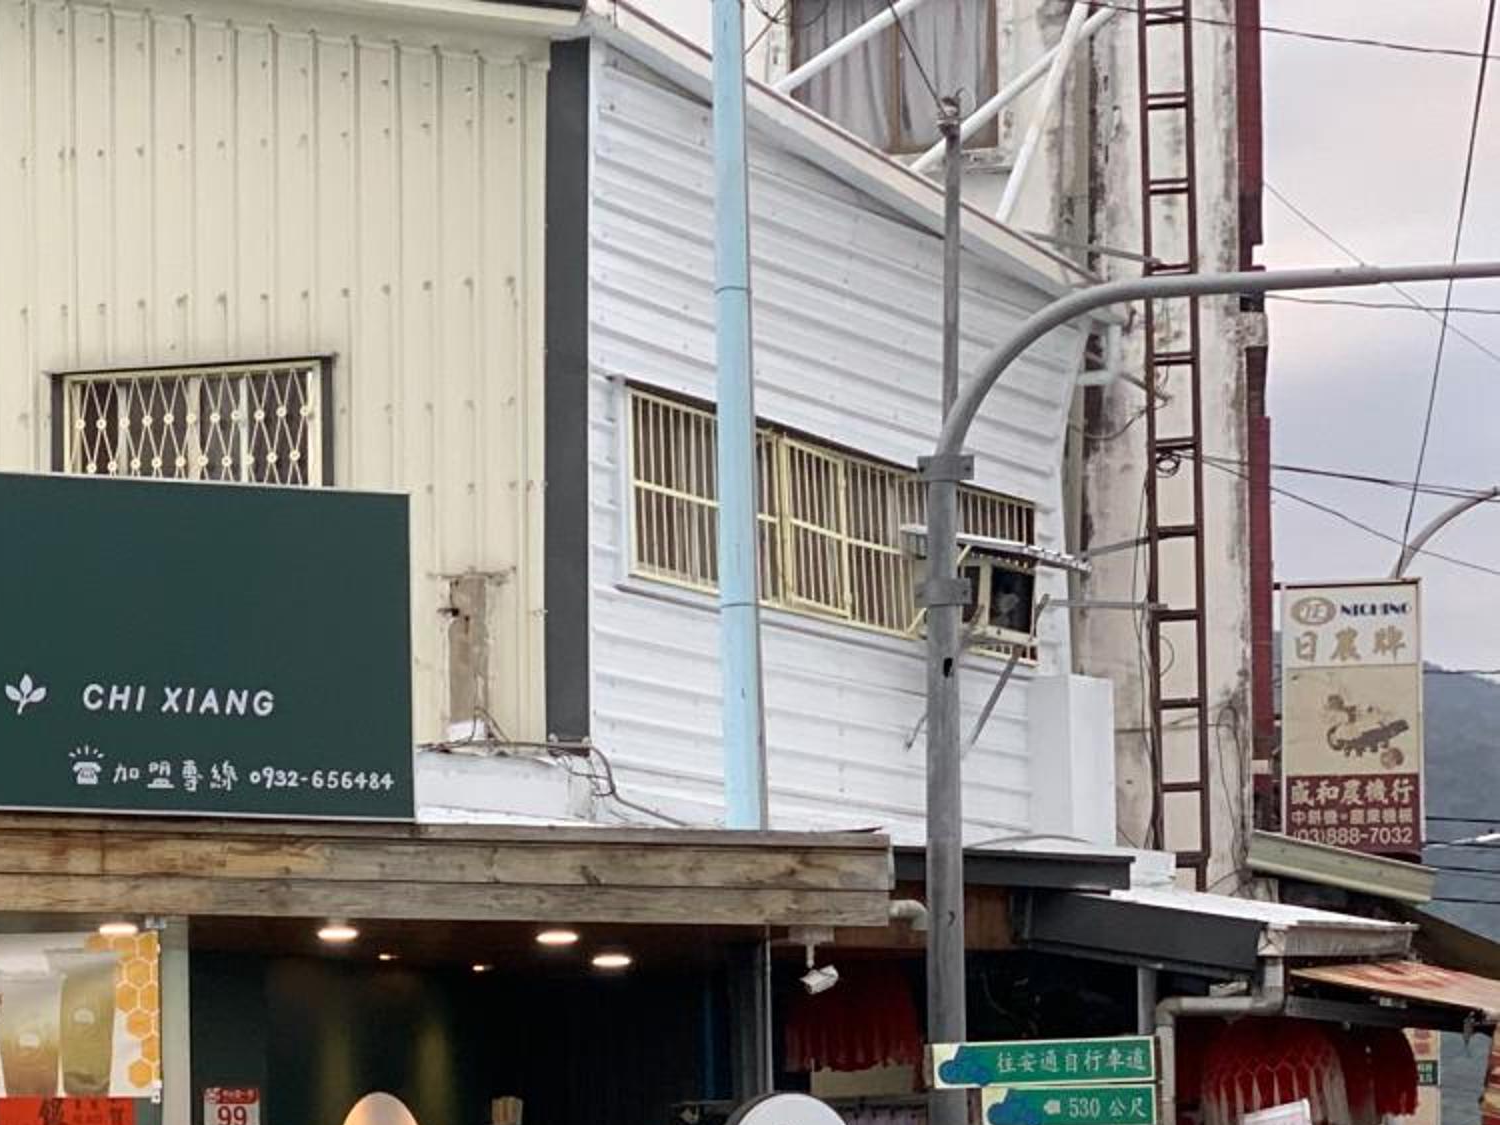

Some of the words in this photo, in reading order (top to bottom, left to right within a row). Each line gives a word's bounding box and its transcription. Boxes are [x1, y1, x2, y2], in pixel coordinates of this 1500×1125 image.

[82, 683, 146, 711] CHI
[160, 686, 275, 717] XIANG
[1068, 1098, 1100, 1118] 530
[1108, 1097, 1146, 1117] 公尺
